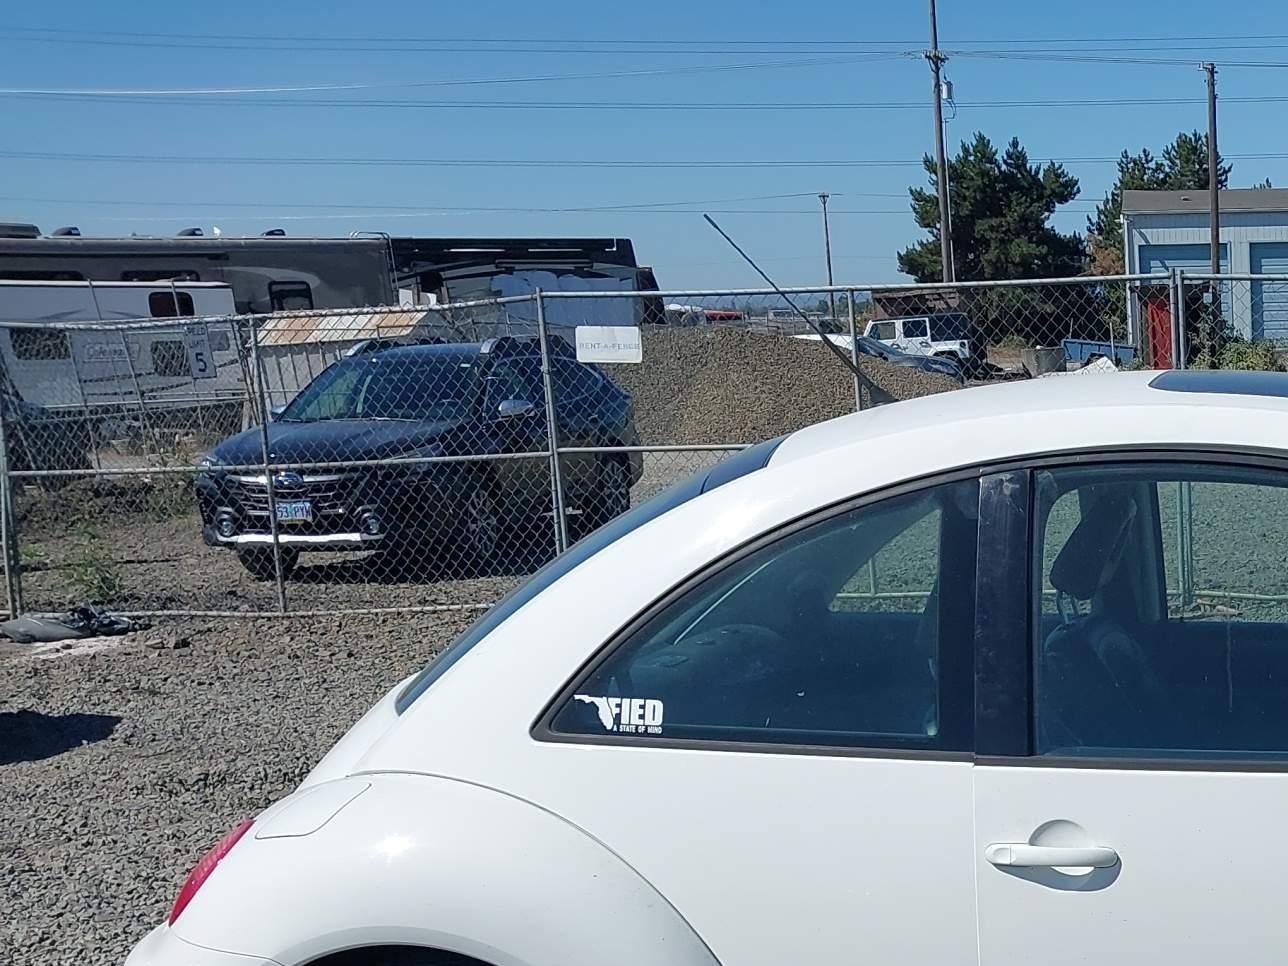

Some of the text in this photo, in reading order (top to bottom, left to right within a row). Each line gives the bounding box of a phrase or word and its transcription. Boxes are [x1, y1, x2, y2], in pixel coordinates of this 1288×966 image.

[195, 352, 207, 372] 5
[607, 698, 663, 725] FIED
[619, 725, 636, 733] STATE
[637, 725, 646, 733] OF
[647, 726, 663, 734] MIND
